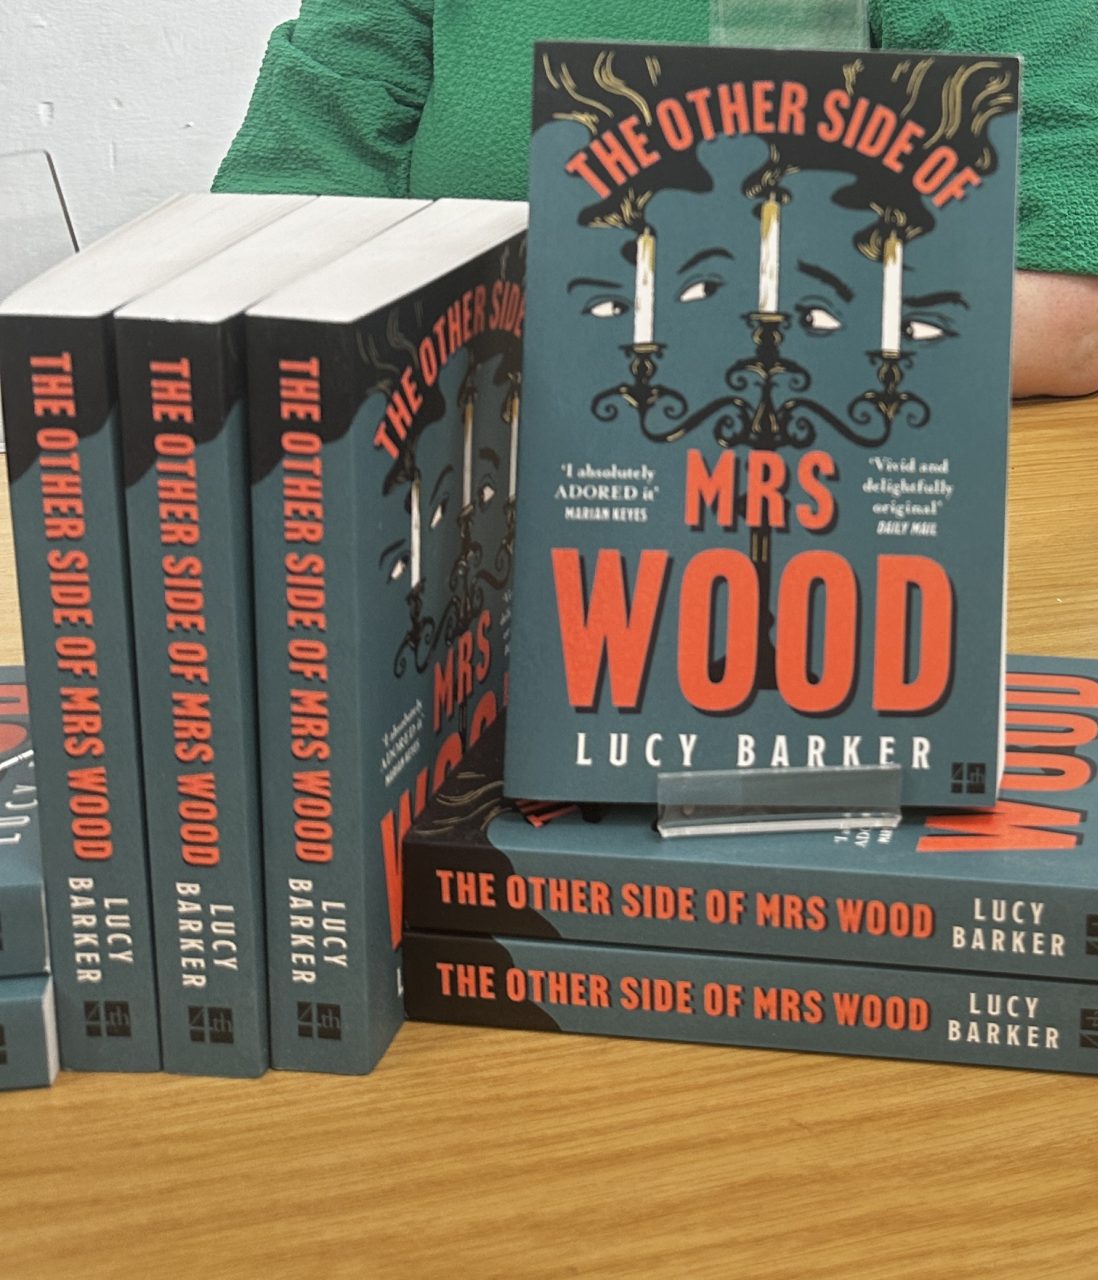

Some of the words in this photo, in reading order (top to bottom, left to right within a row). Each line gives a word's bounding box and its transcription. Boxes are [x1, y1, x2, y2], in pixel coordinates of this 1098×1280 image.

[565, 115, 660, 200] THE
[656, 81, 808, 152] OTHER
[817, 89, 925, 173] SIDE
[912, 145, 982, 208] OF
[30, 353, 76, 418] THE
[150, 357, 193, 424] THE
[278, 357, 321, 422] THE
[374, 366, 424, 459] THE
[419, 284, 487, 387] OTHER
[36, 427, 86, 541] OTHER
[153, 433, 200, 546] OTHER
[281, 431, 324, 545] OTHER
[554, 484, 639, 500] ADORED
[577, 463, 655, 484] absolutely
[685, 449, 838, 530] MRS
[862, 477, 954, 500] delightfully
[919, 458, 949, 474] and
[565, 506, 610, 520] MARIAN
[612, 507, 648, 522] KEYES
[877, 520, 909, 535] DAILY
[911, 521, 938, 536] MAIL
[46, 549, 93, 627] SIDE
[162, 555, 206, 633] SIDE
[284, 552, 326, 630] SIDE
[55, 636, 98, 678] OF
[167, 642, 209, 683] OF
[288, 639, 328, 681] OF
[551, 548, 955, 713] WOOD
[434, 609, 491, 732] MRS
[60, 687, 105, 757] MRS
[172, 687, 212, 763] MRS
[290, 688, 331, 762] MRS
[576, 733, 697, 766] LUCY
[738, 734, 931, 769] BARKER
[67, 767, 113, 860] WOOD
[177, 772, 220, 868] WOOD
[293, 770, 334, 863] WOOD
[68, 877, 102, 984] BARKER
[103, 897, 134, 963] LUCY
[175, 881, 207, 988] BARKER
[209, 904, 239, 971] LUCY
[288, 877, 316, 985] BARKER
[322, 900, 348, 969] LUCY
[435, 869, 497, 907] THE
[507, 875, 610, 918] OTHER
[620, 882, 692, 923] SIDE
[705, 888, 745, 925] OF
[755, 894, 825, 932] MRS
[836, 899, 935, 939] WOOD
[974, 897, 1045, 925] LUCY
[952, 925, 1066, 957] BARKER
[435, 962, 496, 999] THE
[507, 969, 610, 1009] OTHER
[619, 975, 691, 1014] SIDE
[704, 980, 743, 1017] OF
[753, 984, 823, 1023] MRS
[834, 989, 931, 1031] WOOD
[969, 992, 1040, 1019] LUCY
[948, 1019, 1059, 1049] BARKER
